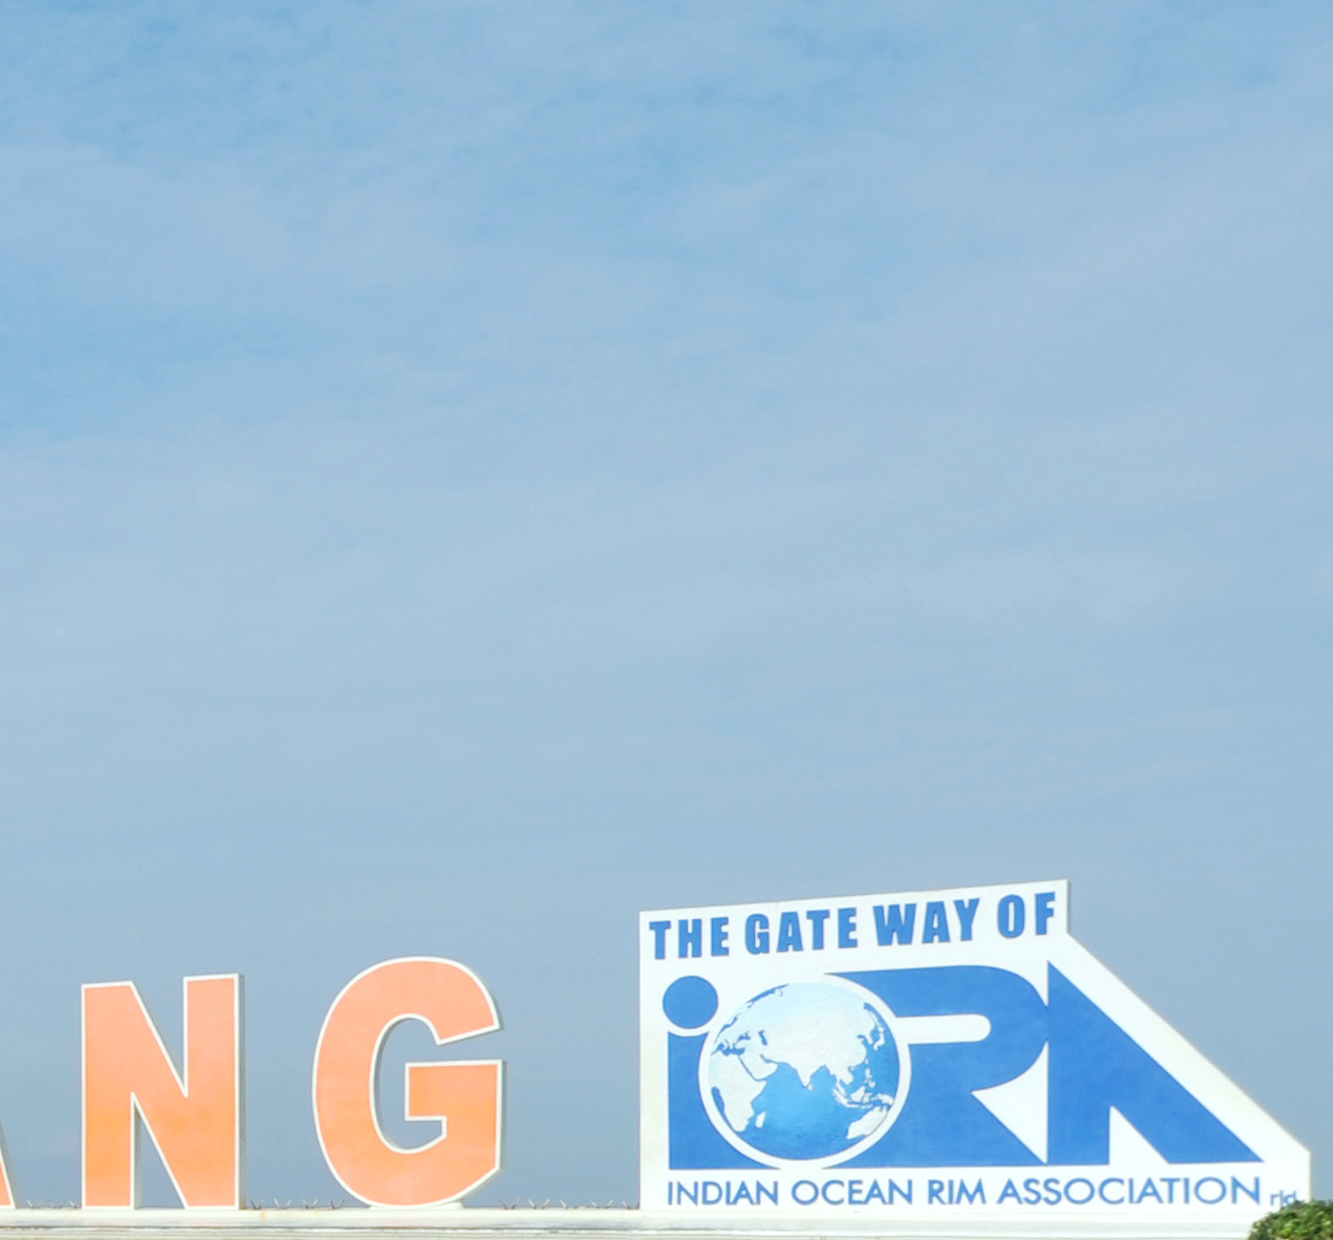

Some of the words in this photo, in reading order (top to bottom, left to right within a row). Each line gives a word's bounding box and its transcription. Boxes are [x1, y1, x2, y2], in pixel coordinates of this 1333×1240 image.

[649, 916, 730, 960] THE
[744, 907, 859, 955] GATE
[872, 897, 981, 947] WAY
[997, 891, 1056, 939] OF
[667, 1180, 779, 1206] INDIAN
[791, 1178, 913, 1205] OCEAN
[927, 1177, 987, 1205] RIM
[996, 1175, 1261, 1206] ASSOCIATION
